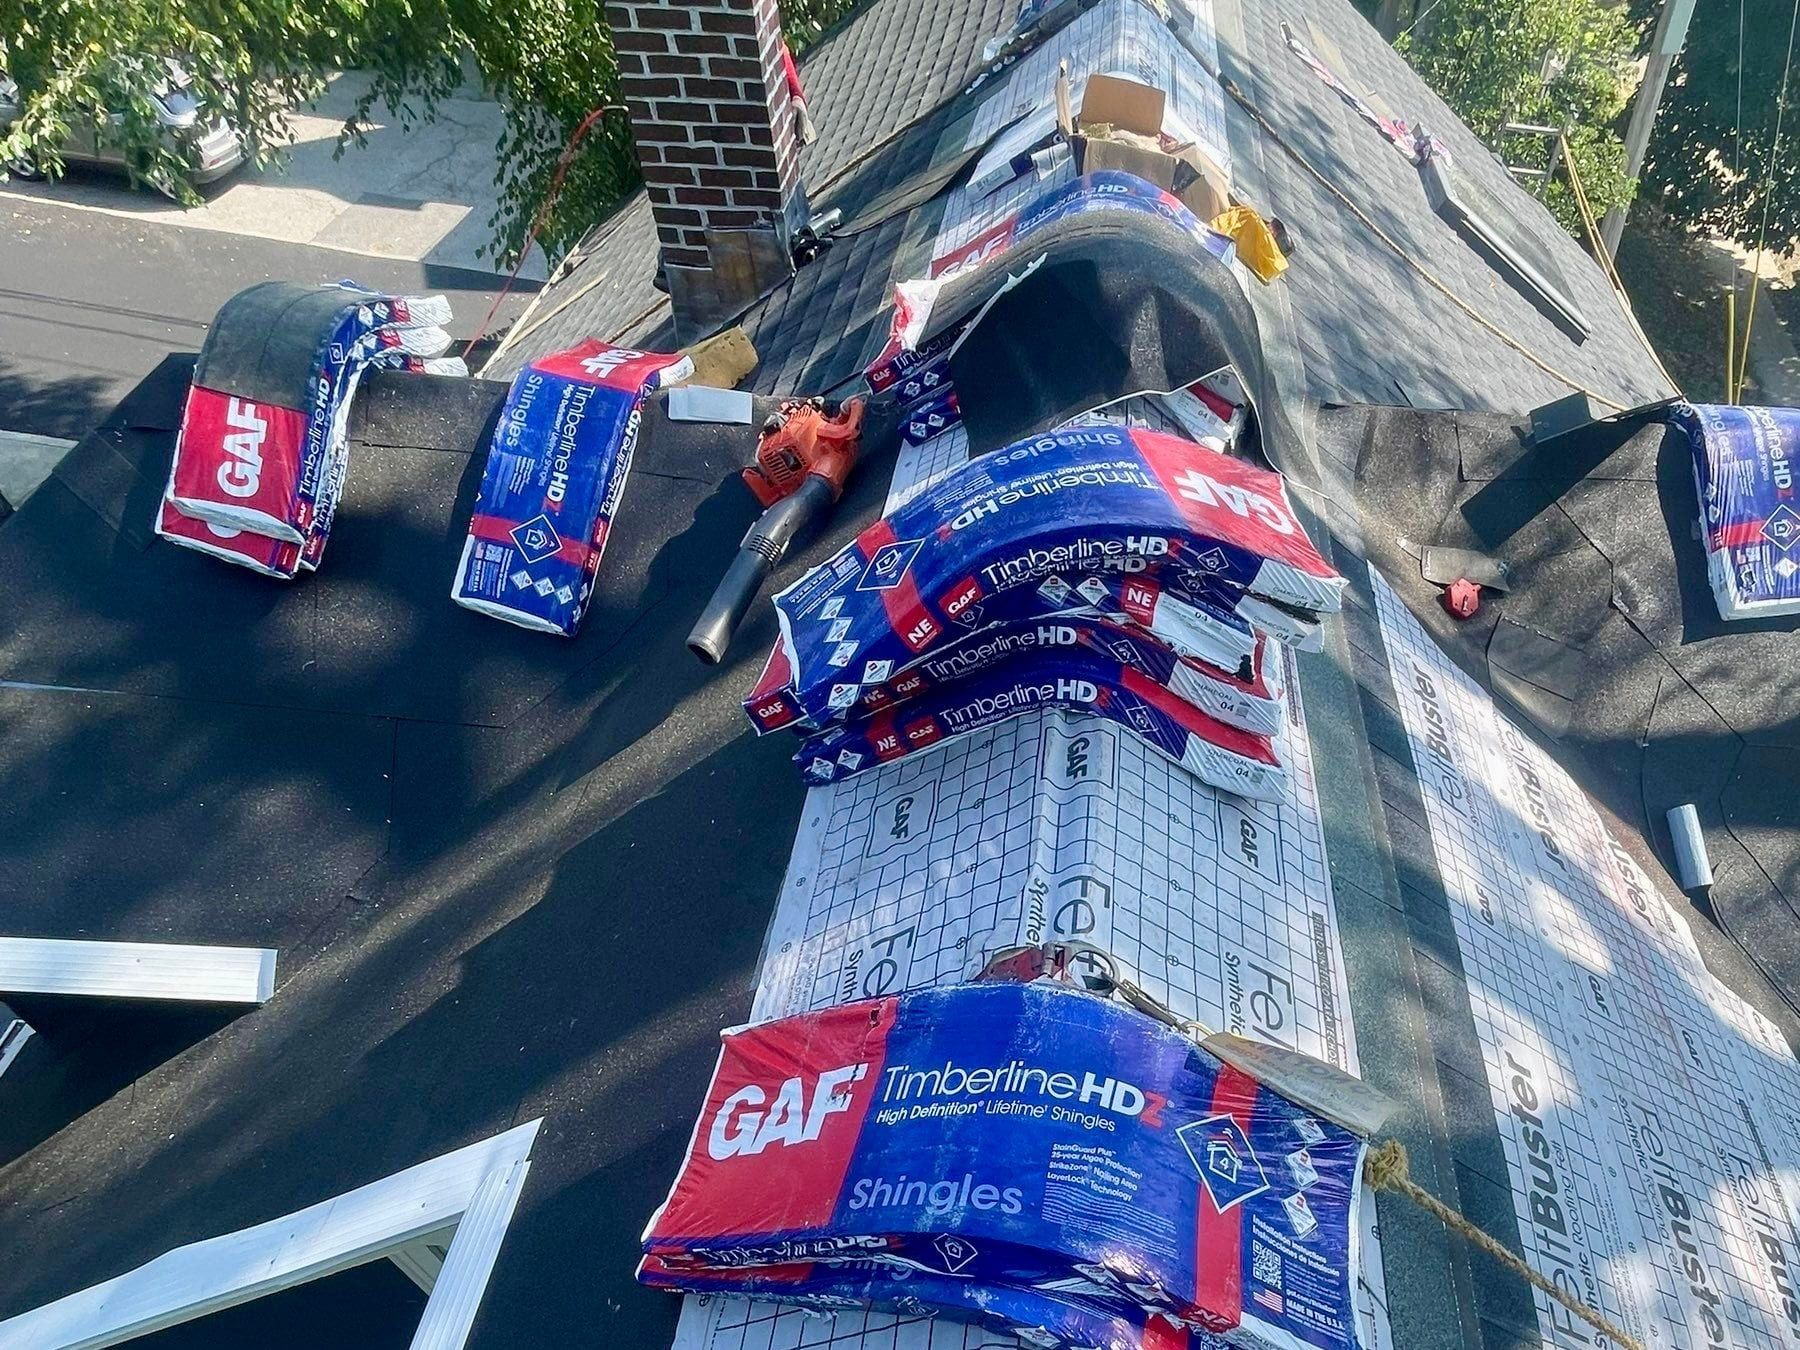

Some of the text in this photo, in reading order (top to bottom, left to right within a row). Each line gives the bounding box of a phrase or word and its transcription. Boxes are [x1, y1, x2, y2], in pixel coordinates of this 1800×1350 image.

[506, 374, 543, 448] Shingles
[216, 397, 268, 498] GAF
[993, 433, 1122, 466] Shingles
[1172, 468, 1294, 536] GAF
[947, 587, 978, 617] GAF
[1127, 587, 1153, 607] NE
[908, 618, 933, 644] NE
[1253, 615, 1291, 634] CHARCOAL
[1276, 631, 1289, 641] 04
[896, 676, 921, 694] GAF
[758, 701, 784, 719] GAF
[951, 723, 970, 734] High
[970, 711, 1005, 727] Definition
[1220, 701, 1235, 712] 04
[876, 735, 898, 752] NE
[908, 725, 935, 740] GAF
[1412, 661, 1467, 819] FeltBuster
[1065, 737, 1090, 780] GAF
[1235, 767, 1249, 778] 04
[889, 796, 914, 839] GAF
[1239, 818, 1259, 869] GAF
[1474, 884, 1495, 926] GAF
[1223, 951, 1246, 1036] Synthetic
[1587, 974, 1610, 1018] GAF
[1323, 1024, 1339, 1064] TECHOS
[1682, 1030, 1706, 1071] GAF
[707, 1062, 869, 1161] GAF
[876, 1107, 908, 1125] High
[909, 1102, 977, 1121] Definition
[1051, 1108, 1116, 1133] Shingles
[1051, 1151, 1080, 1161] 25-year
[1081, 1153, 1105, 1164] Algae
[1052, 1143, 1097, 1155] StainGuard
[1551, 1139, 1566, 1172] Felt
[1046, 1171, 1133, 1202] LayerLock Technology
[1049, 1161, 1138, 1191] StrikeZone Nailing Area
[1619, 1093, 1648, 1170] Synthetic
[1669, 1245, 1684, 1276] Felt
[849, 1173, 1023, 1216] Shingles
[1564, 1178, 1584, 1245] Roofing
